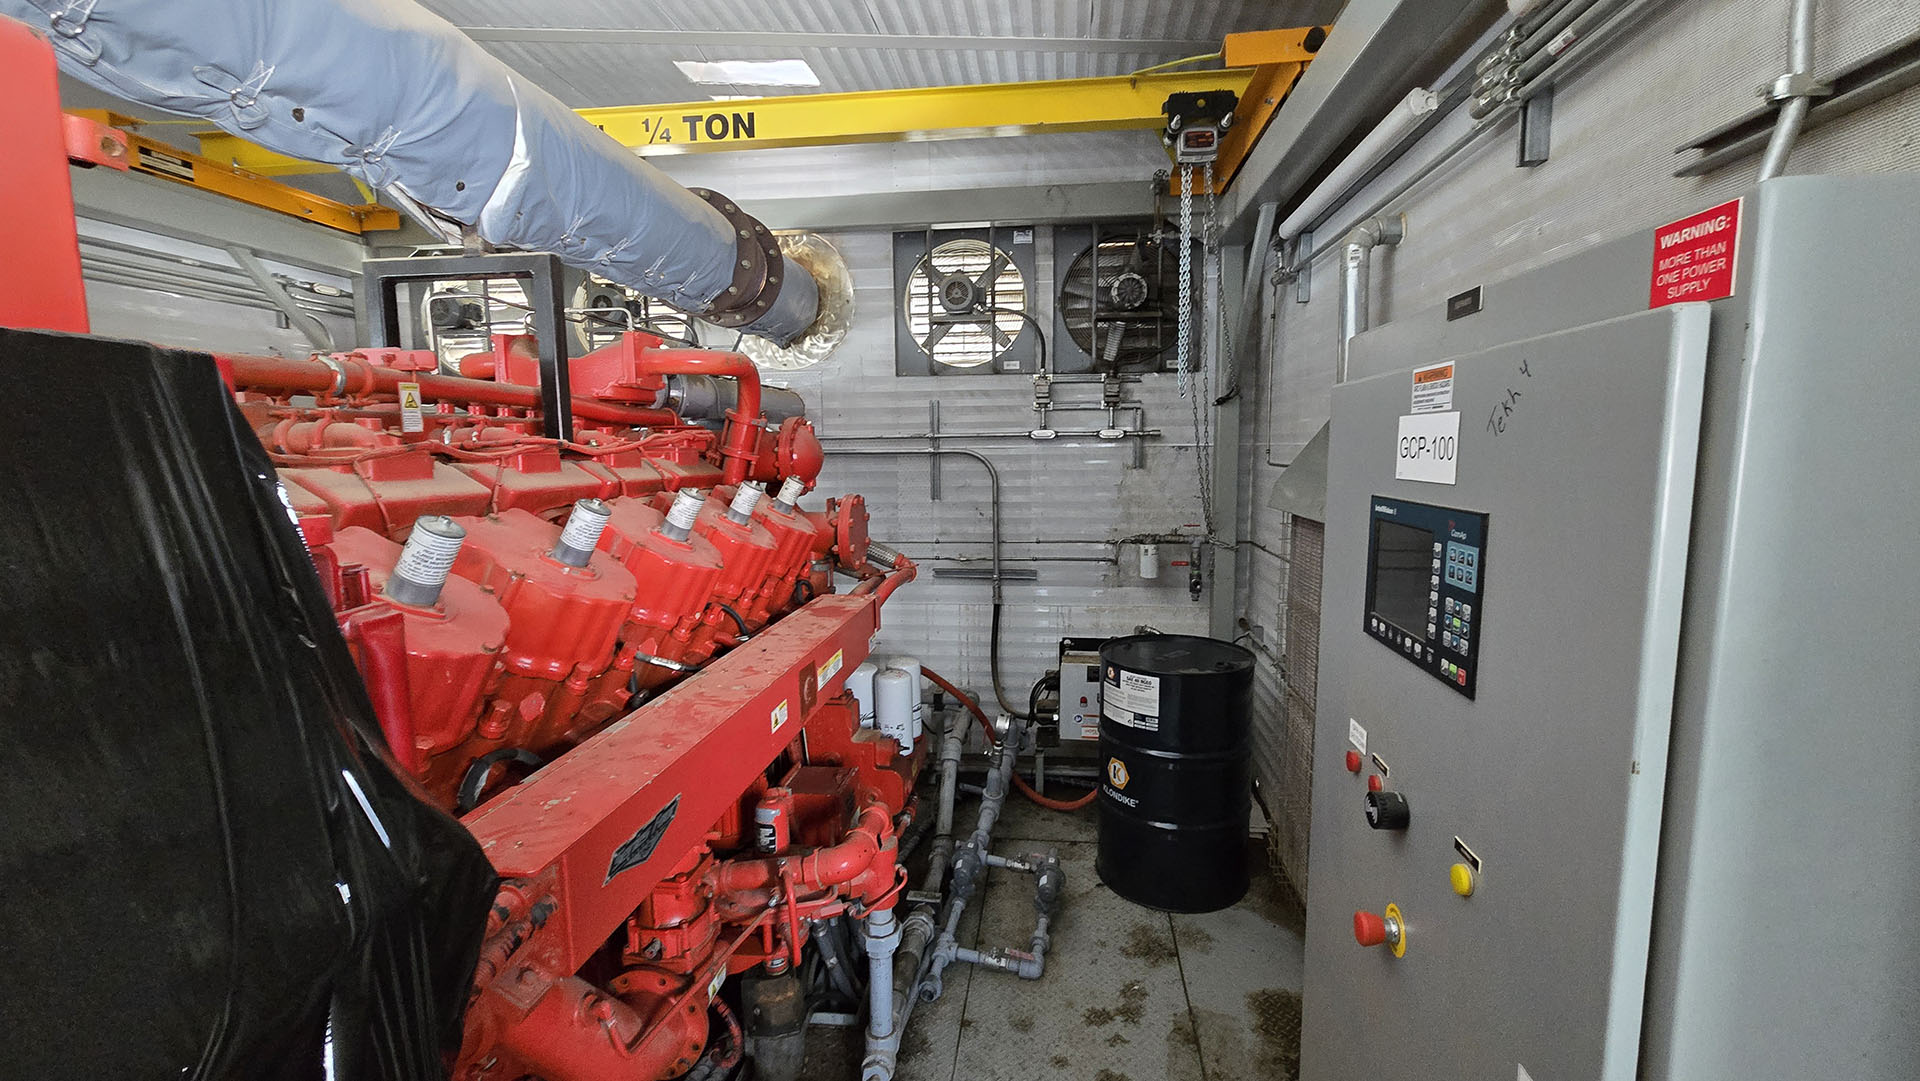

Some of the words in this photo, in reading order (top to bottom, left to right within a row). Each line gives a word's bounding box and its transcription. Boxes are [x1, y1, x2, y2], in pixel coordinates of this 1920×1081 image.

[682, 112, 756, 142] TON
[1660, 215, 1731, 250] WARNING:
[1658, 250, 1693, 272] MORE
[1694, 240, 1727, 261] THAN
[1656, 269, 1681, 287] ONE
[1681, 257, 1727, 280] POWER
[1667, 277, 1712, 299] SUPPLY
[1400, 436, 1455, 461] GCP-100
[1103, 784, 1136, 808] KLONDIKE
